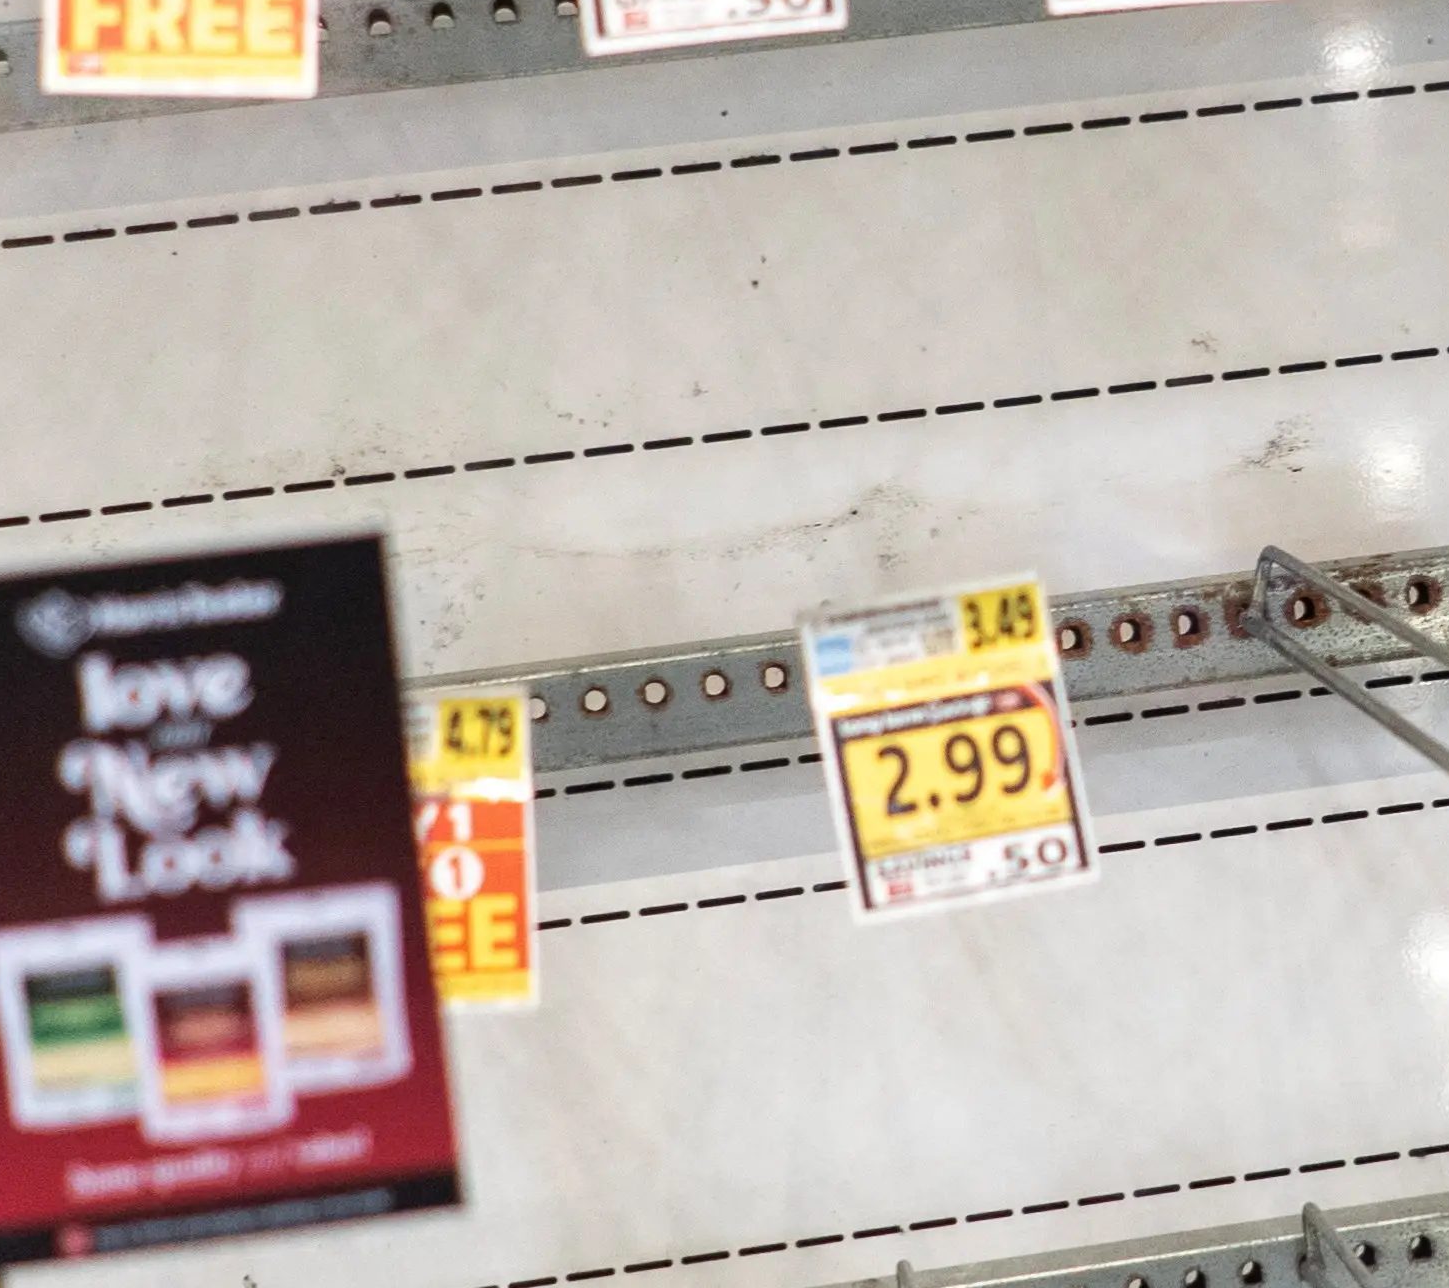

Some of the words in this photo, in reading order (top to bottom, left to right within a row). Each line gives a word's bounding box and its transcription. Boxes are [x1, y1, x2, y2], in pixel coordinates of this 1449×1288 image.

[449, 706, 513, 757] 4.79
[877, 724, 1032, 818] 2.99
[987, 838, 1067, 881] .50
